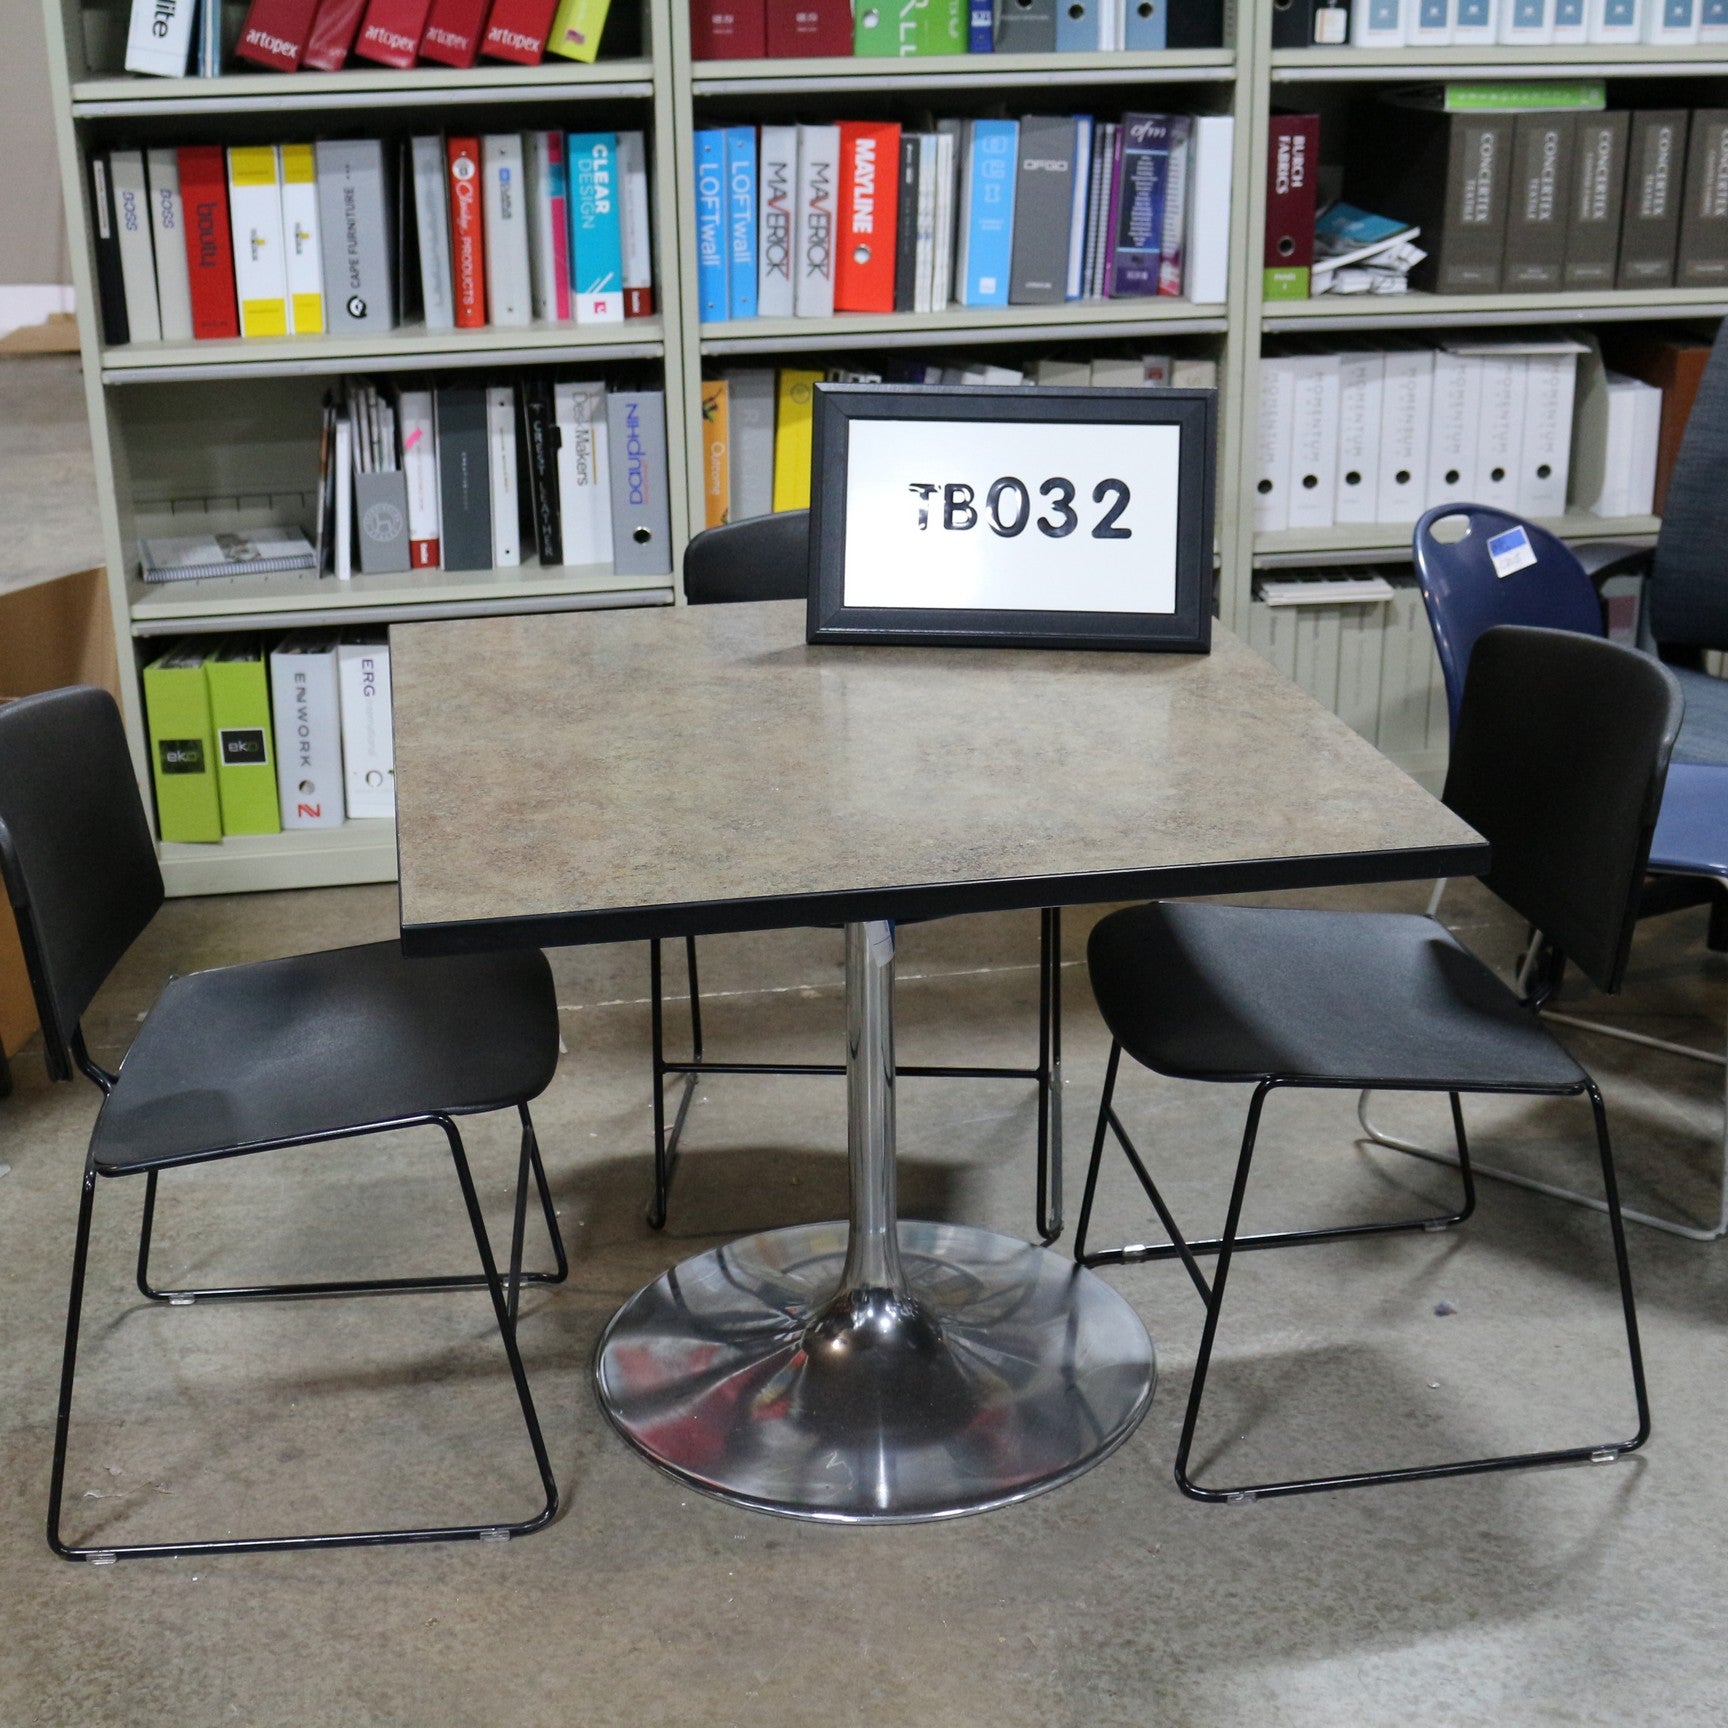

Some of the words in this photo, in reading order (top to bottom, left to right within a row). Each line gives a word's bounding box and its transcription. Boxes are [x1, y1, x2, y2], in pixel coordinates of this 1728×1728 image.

[246, 29, 299, 58] artopex
[365, 26, 416, 52] artopex
[425, 27, 469, 50] artopex
[488, 27, 541, 52] artopex
[592, 144, 610, 215] CLEAR
[852, 138, 876, 234] MAYLINE
[1276, 135, 1291, 195] FABRICS
[1291, 135, 1305, 188] BURCH
[343, 187, 358, 255] FURNITURE
[578, 159, 596, 229] DESIGN
[700, 163, 720, 266] LOFTwall
[731, 161, 752, 263] LOFTwall
[349, 258, 361, 289] CAPE
[461, 236, 474, 305] PRODUCTS
[909, 477, 1132, 539] TB032
[362, 659, 375, 697] ERG
[294, 672, 311, 767] ENWORK
